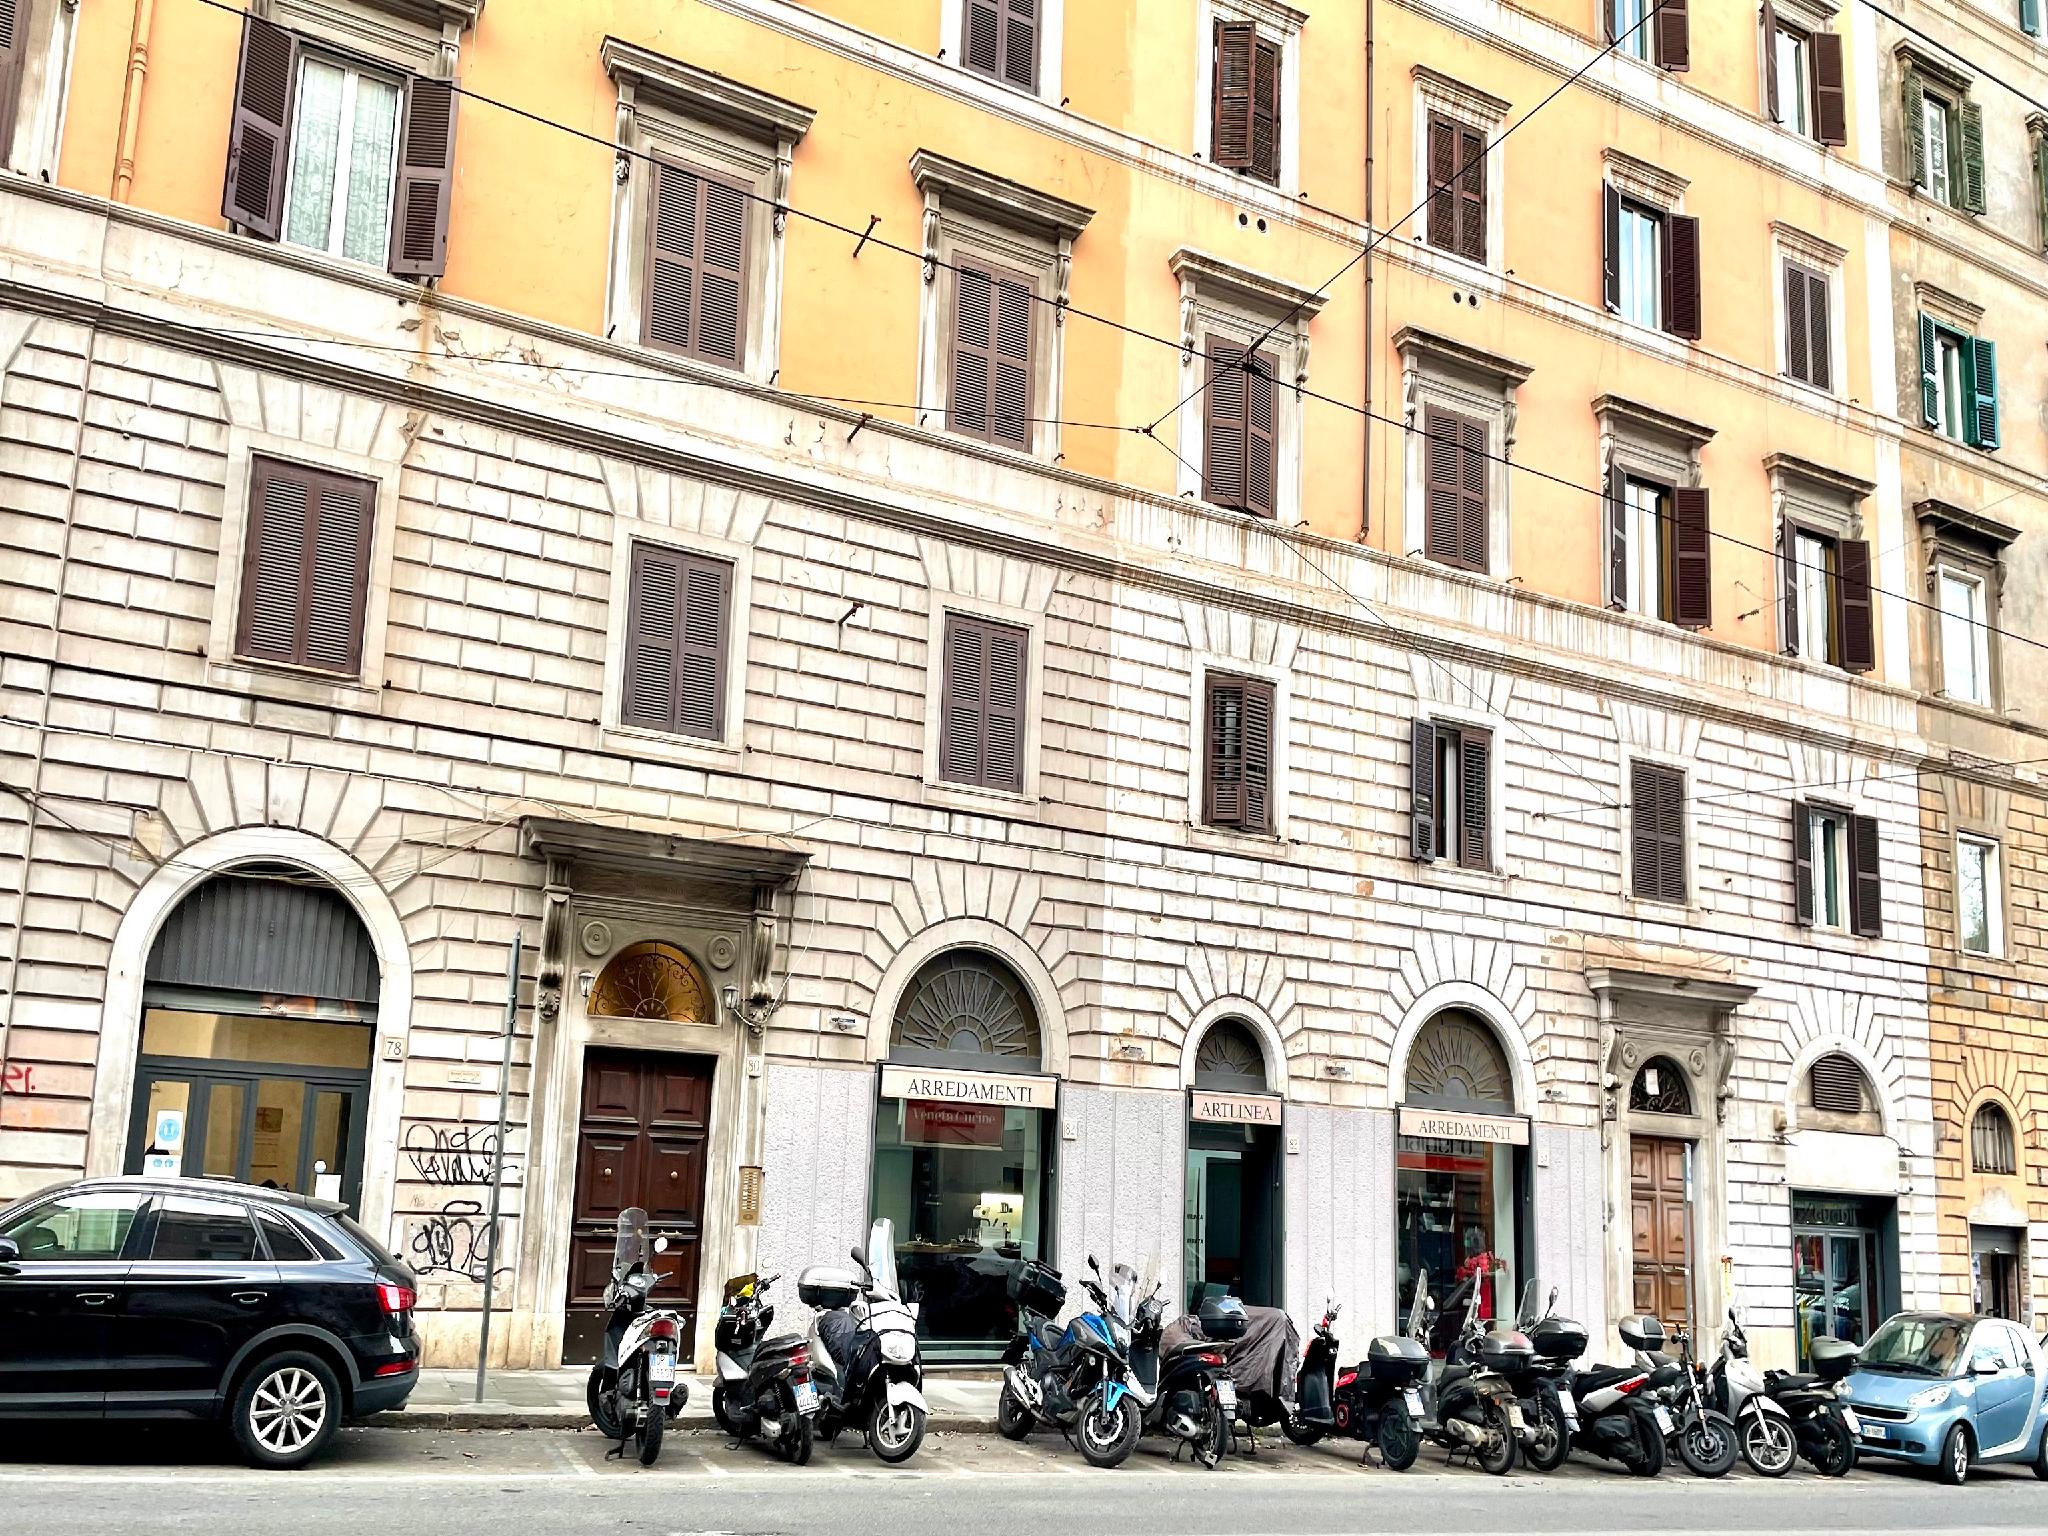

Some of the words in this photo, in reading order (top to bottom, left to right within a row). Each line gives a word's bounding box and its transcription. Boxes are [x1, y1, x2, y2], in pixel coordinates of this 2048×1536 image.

[387, 1041, 402, 1056] 78
[907, 1078, 1033, 1103] ARREDAMENTI
[913, 1106, 953, 1122] Veneta
[955, 1110, 996, 1125] Cucine
[1200, 1101, 1274, 1121] ARTLINEA
[1418, 1119, 1512, 1140] ARREDAMENTI
